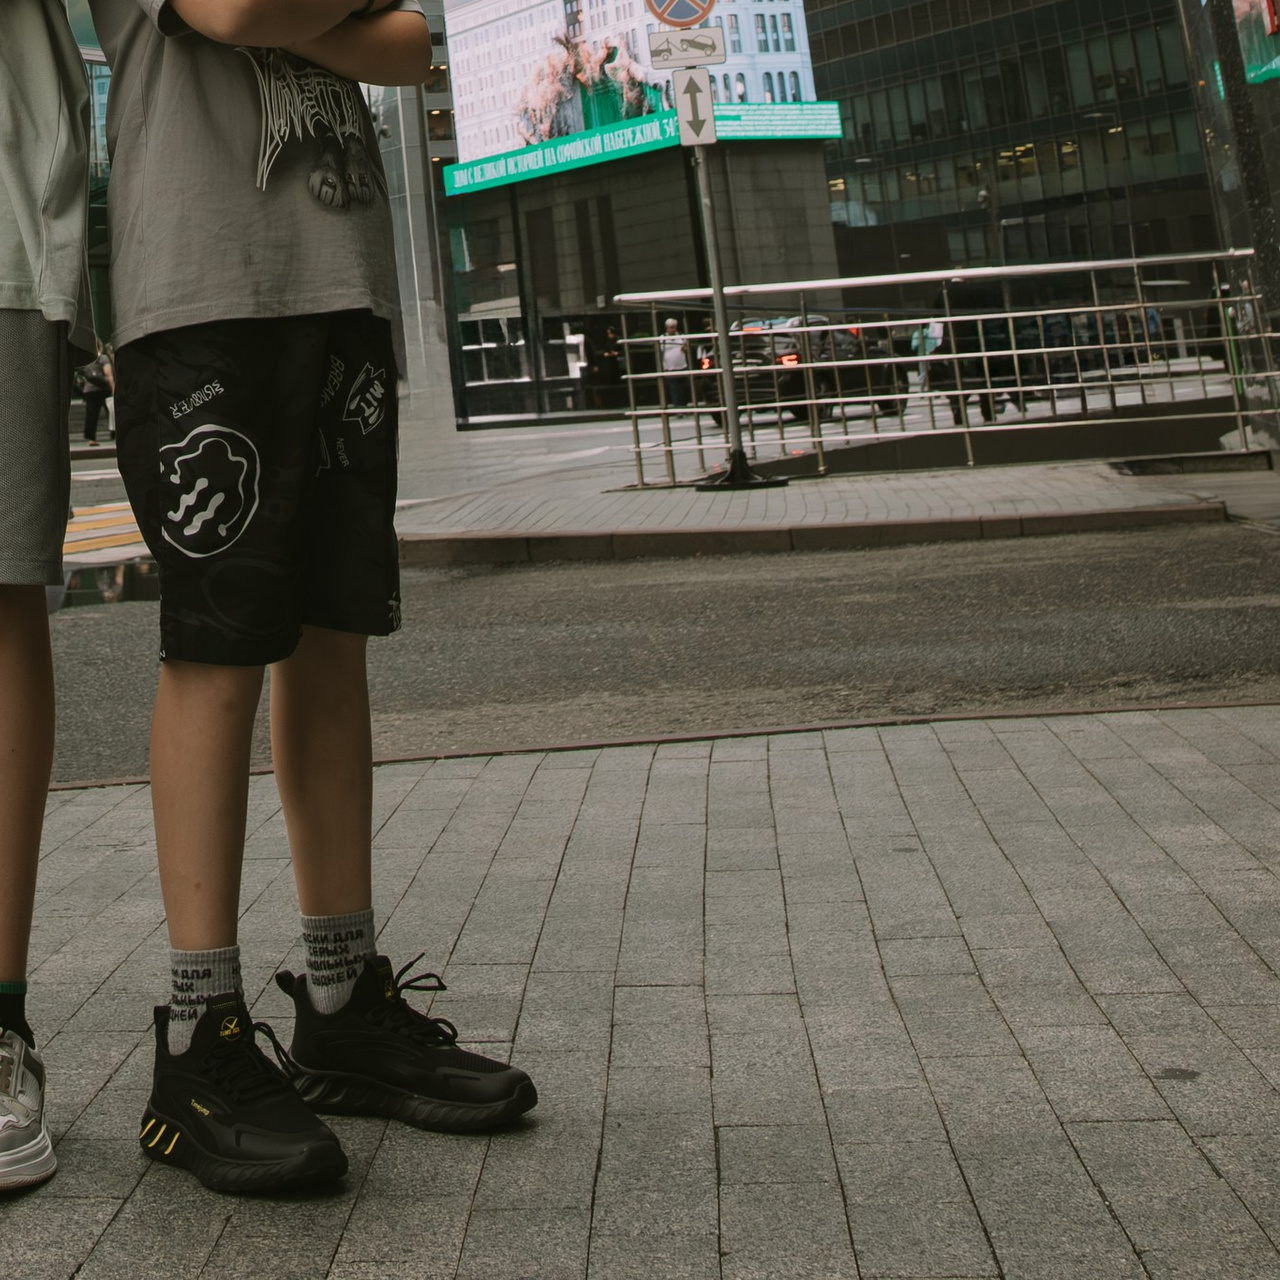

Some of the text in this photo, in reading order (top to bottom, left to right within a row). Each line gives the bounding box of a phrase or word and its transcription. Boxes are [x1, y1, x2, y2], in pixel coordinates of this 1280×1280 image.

[543, 146, 557, 167] НА
[335, 437, 351, 468] NEVER
[333, 929, 364, 944] ДЛЯ
[181, 968, 212, 980] ДЛЯ
